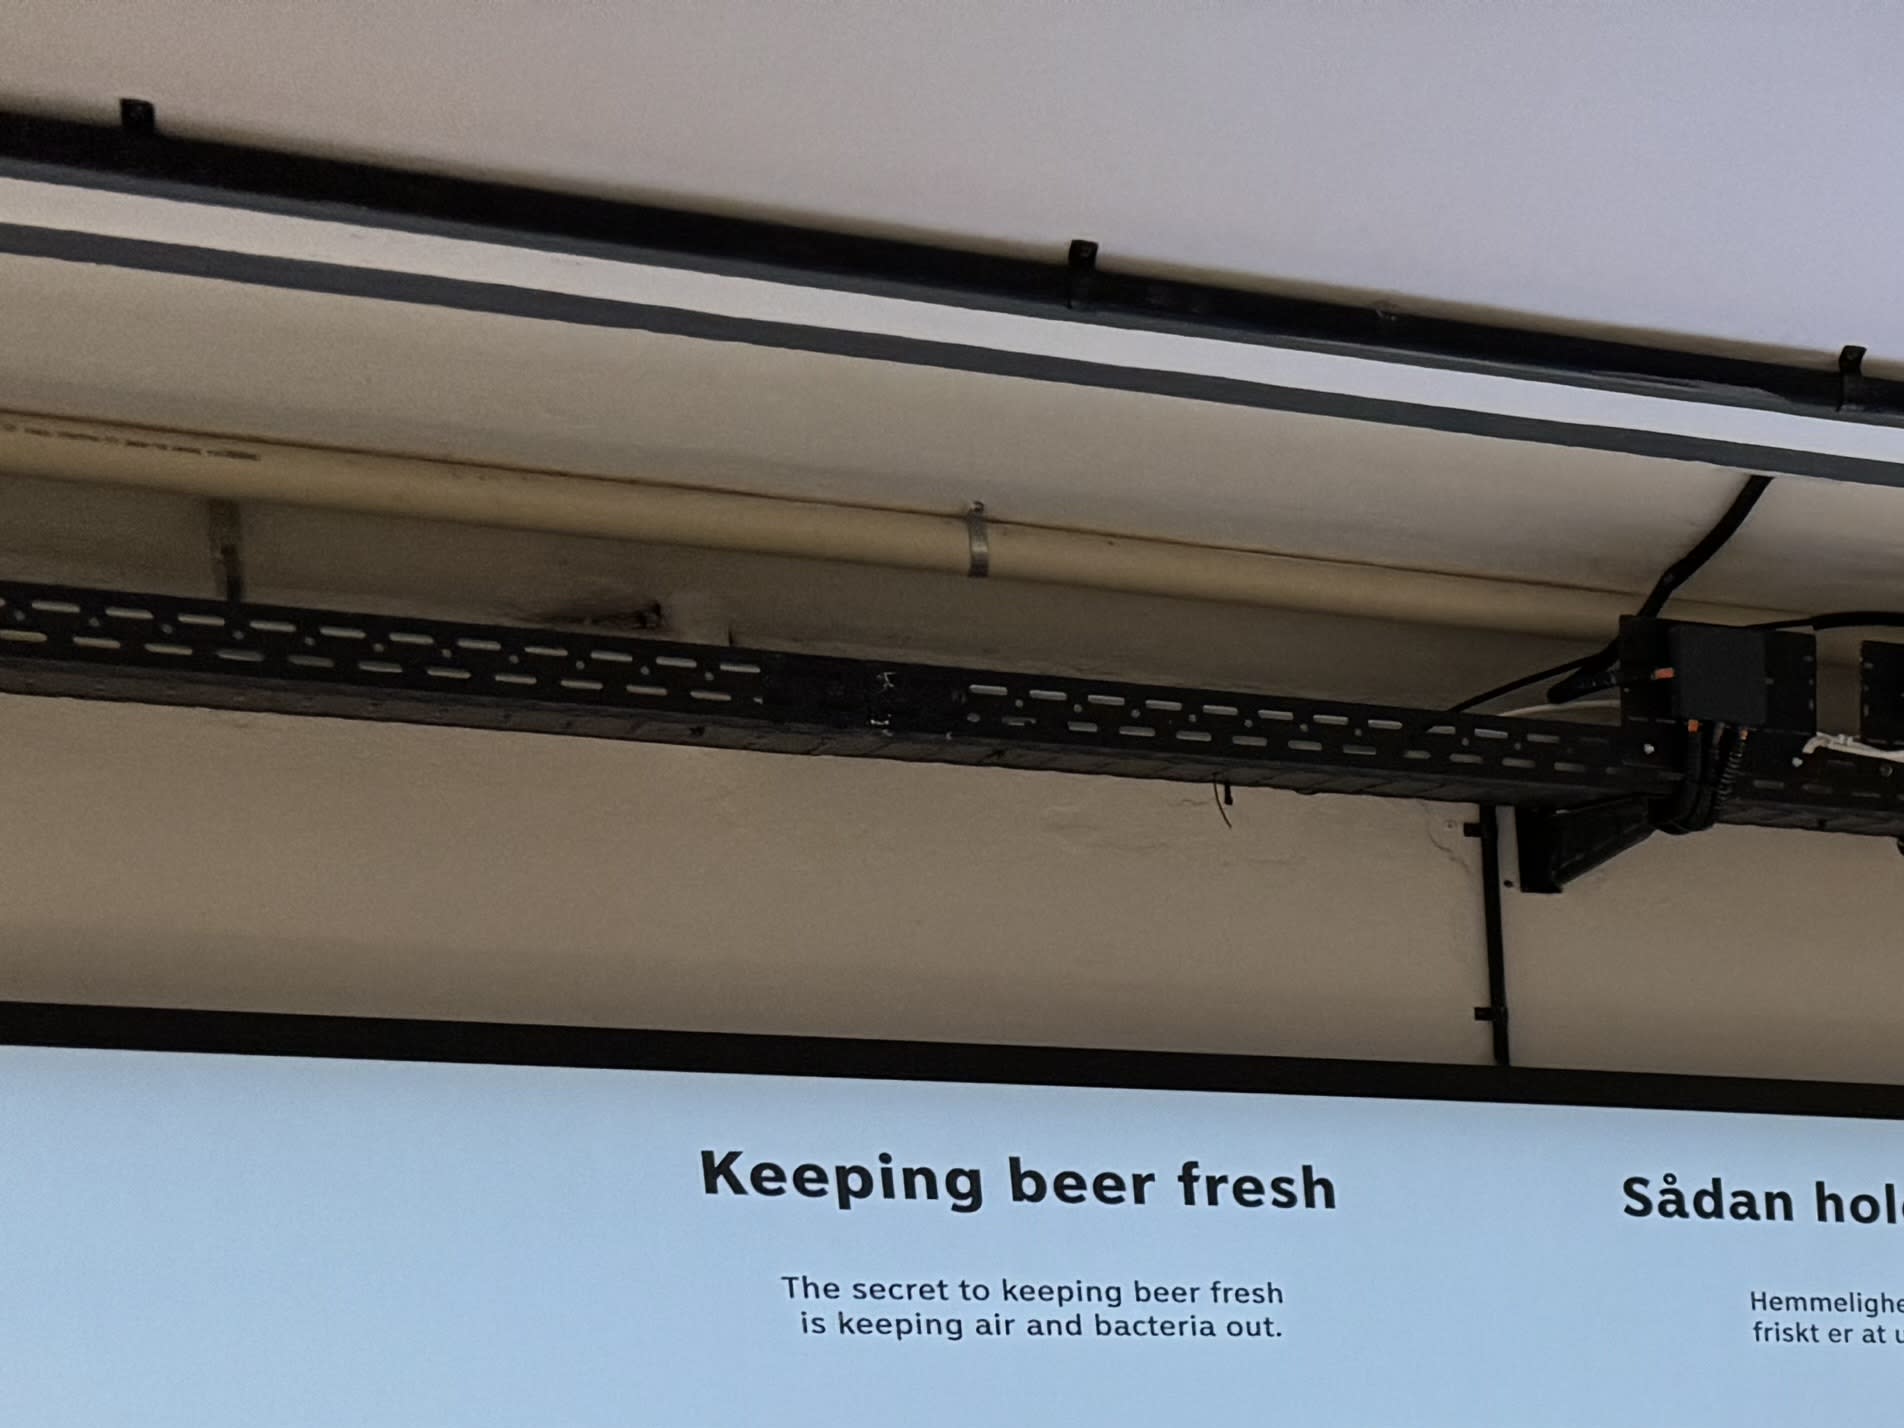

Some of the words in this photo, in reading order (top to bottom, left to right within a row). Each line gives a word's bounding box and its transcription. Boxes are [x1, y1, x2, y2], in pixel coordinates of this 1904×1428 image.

[700, 1150, 984, 1214] Keeping
[1008, 1156, 1156, 1206] beer
[1177, 1160, 1336, 1210] fresh
[1622, 1172, 1794, 1222] Sådan
[780, 1274, 840, 1300] The
[852, 1279, 950, 1302] secret
[958, 1279, 990, 1302] to
[1002, 1277, 1122, 1308] keeping
[1134, 1279, 1201, 1304] beer
[1209, 1280, 1284, 1304] fresh
[800, 1311, 826, 1334] is
[838, 1311, 963, 1342] keeping
[975, 1312, 1016, 1336] air
[1026, 1312, 1083, 1337] and
[1094, 1313, 1217, 1338] bacteria
[1226, 1317, 1282, 1338] out.
[1752, 1320, 1820, 1344] friskt
[1828, 1327, 1854, 1344] er
[1862, 1325, 1887, 1344] at
